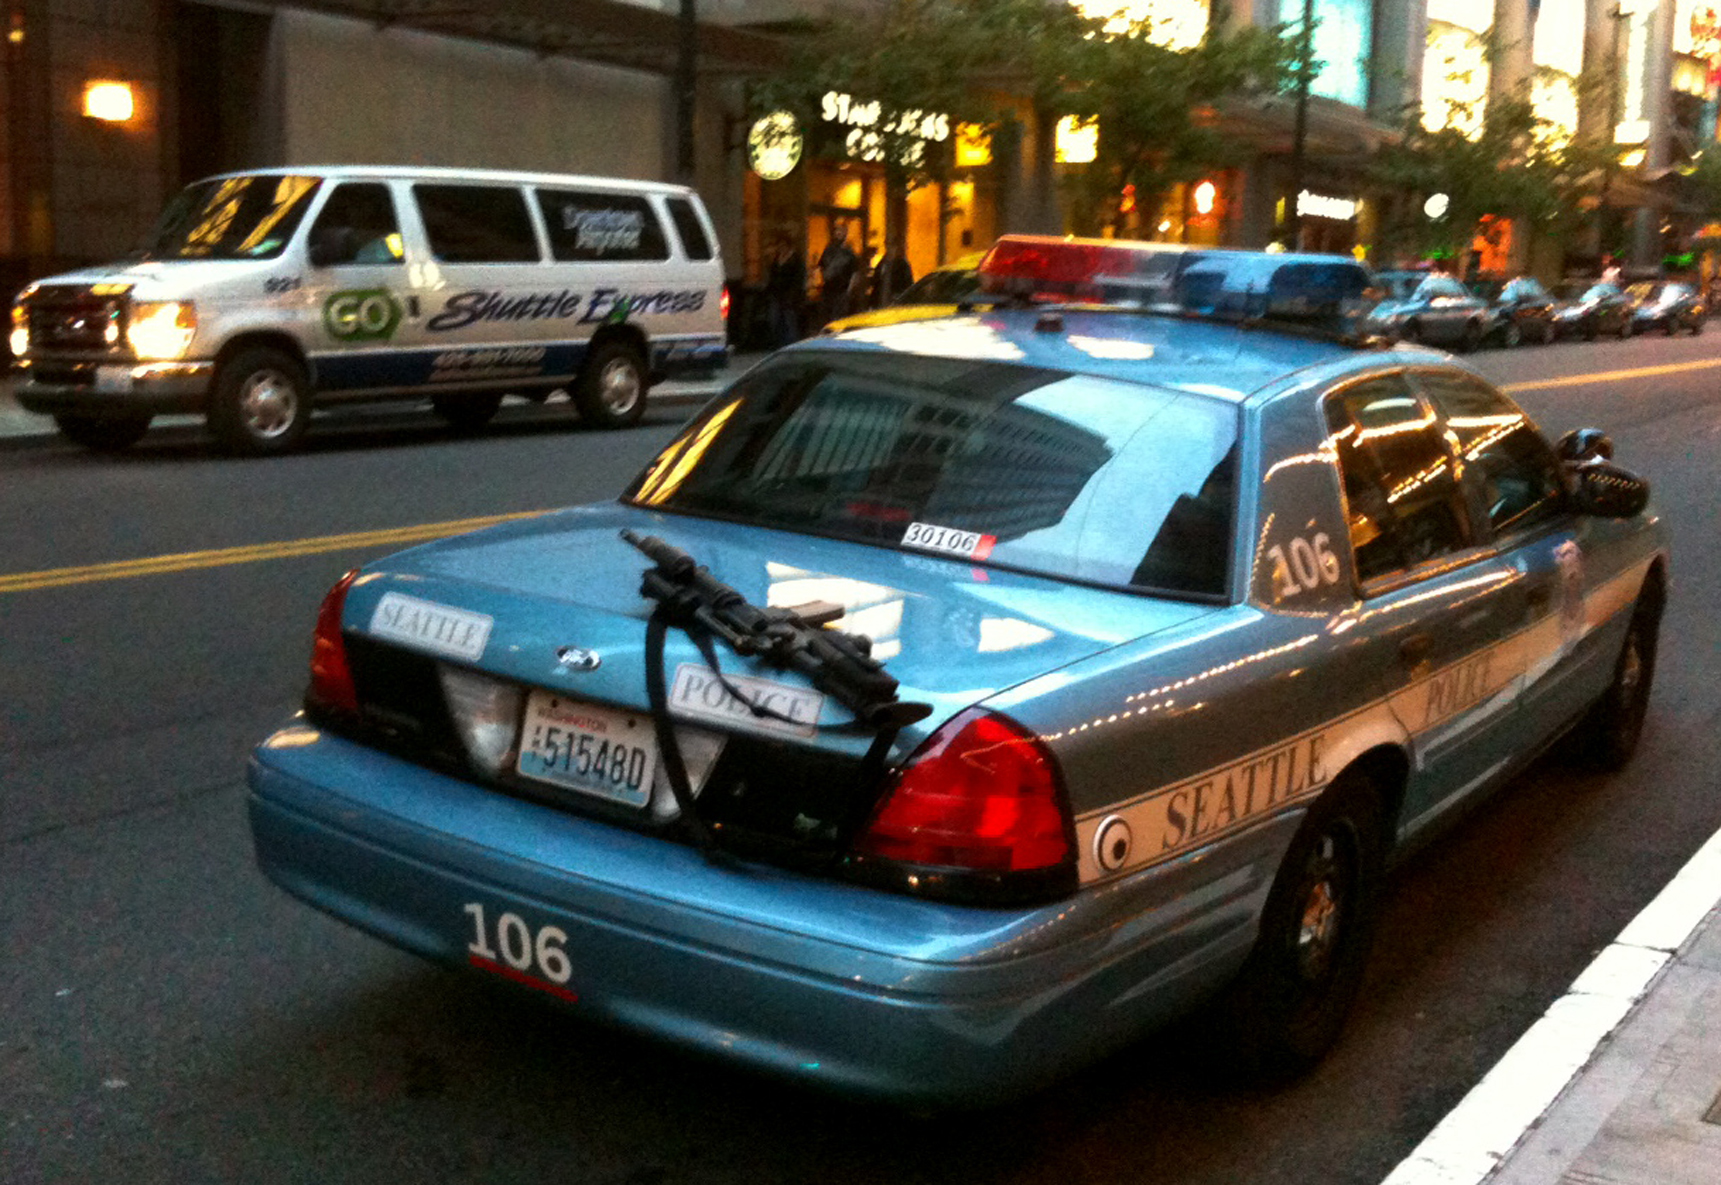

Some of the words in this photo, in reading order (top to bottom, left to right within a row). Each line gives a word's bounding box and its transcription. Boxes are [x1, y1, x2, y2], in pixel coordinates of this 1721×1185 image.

[331, 294, 392, 335] GO
[425, 289, 585, 332] Shuttle
[576, 286, 708, 326] Express
[907, 523, 977, 553] 30106
[1266, 532, 1340, 597] 106
[382, 602, 481, 648] SEATTLE
[543, 726, 646, 791] 51548D
[1161, 734, 1328, 851] SEATTLE
[463, 902, 574, 984] 106
